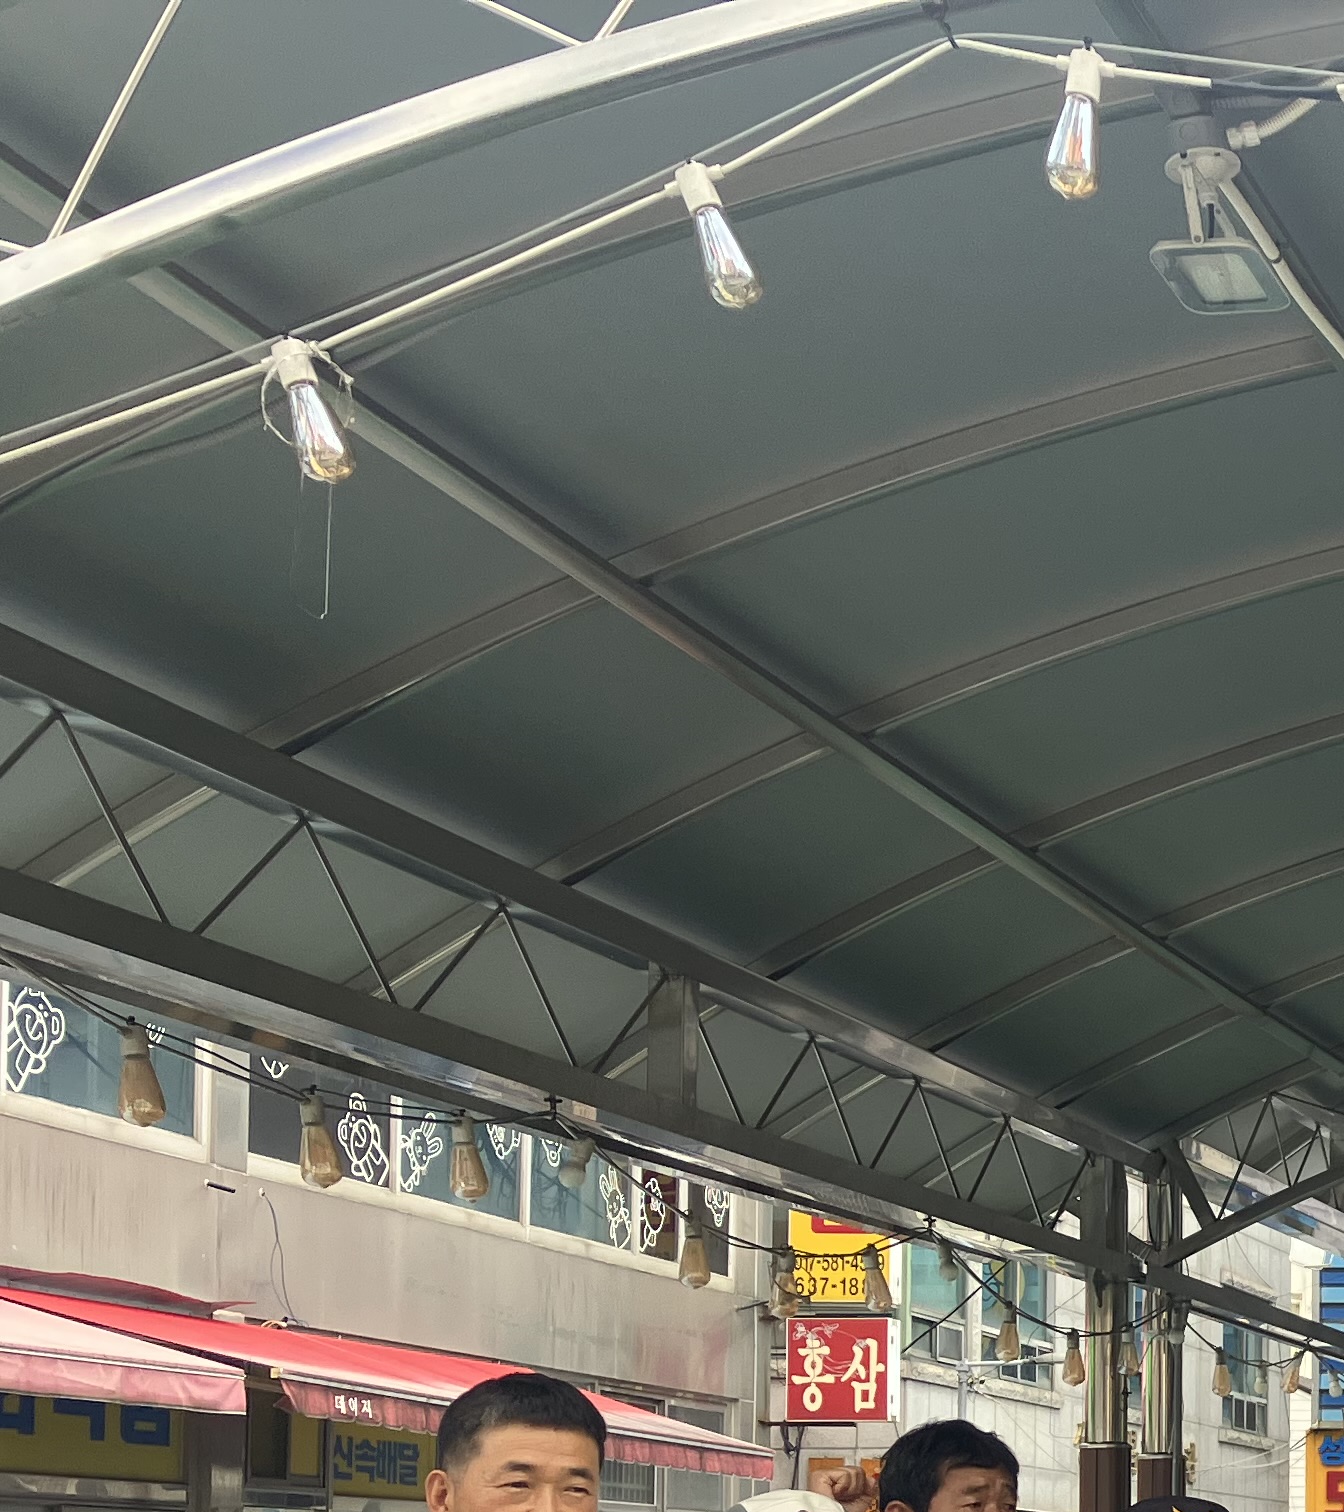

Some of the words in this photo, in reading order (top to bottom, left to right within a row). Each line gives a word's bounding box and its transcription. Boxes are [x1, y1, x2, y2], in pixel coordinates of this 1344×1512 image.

[795, 1276, 866, 1296] 637-18
[791, 1337, 886, 1413] 홍삼
[333, 1434, 420, 1487] 신속배달
